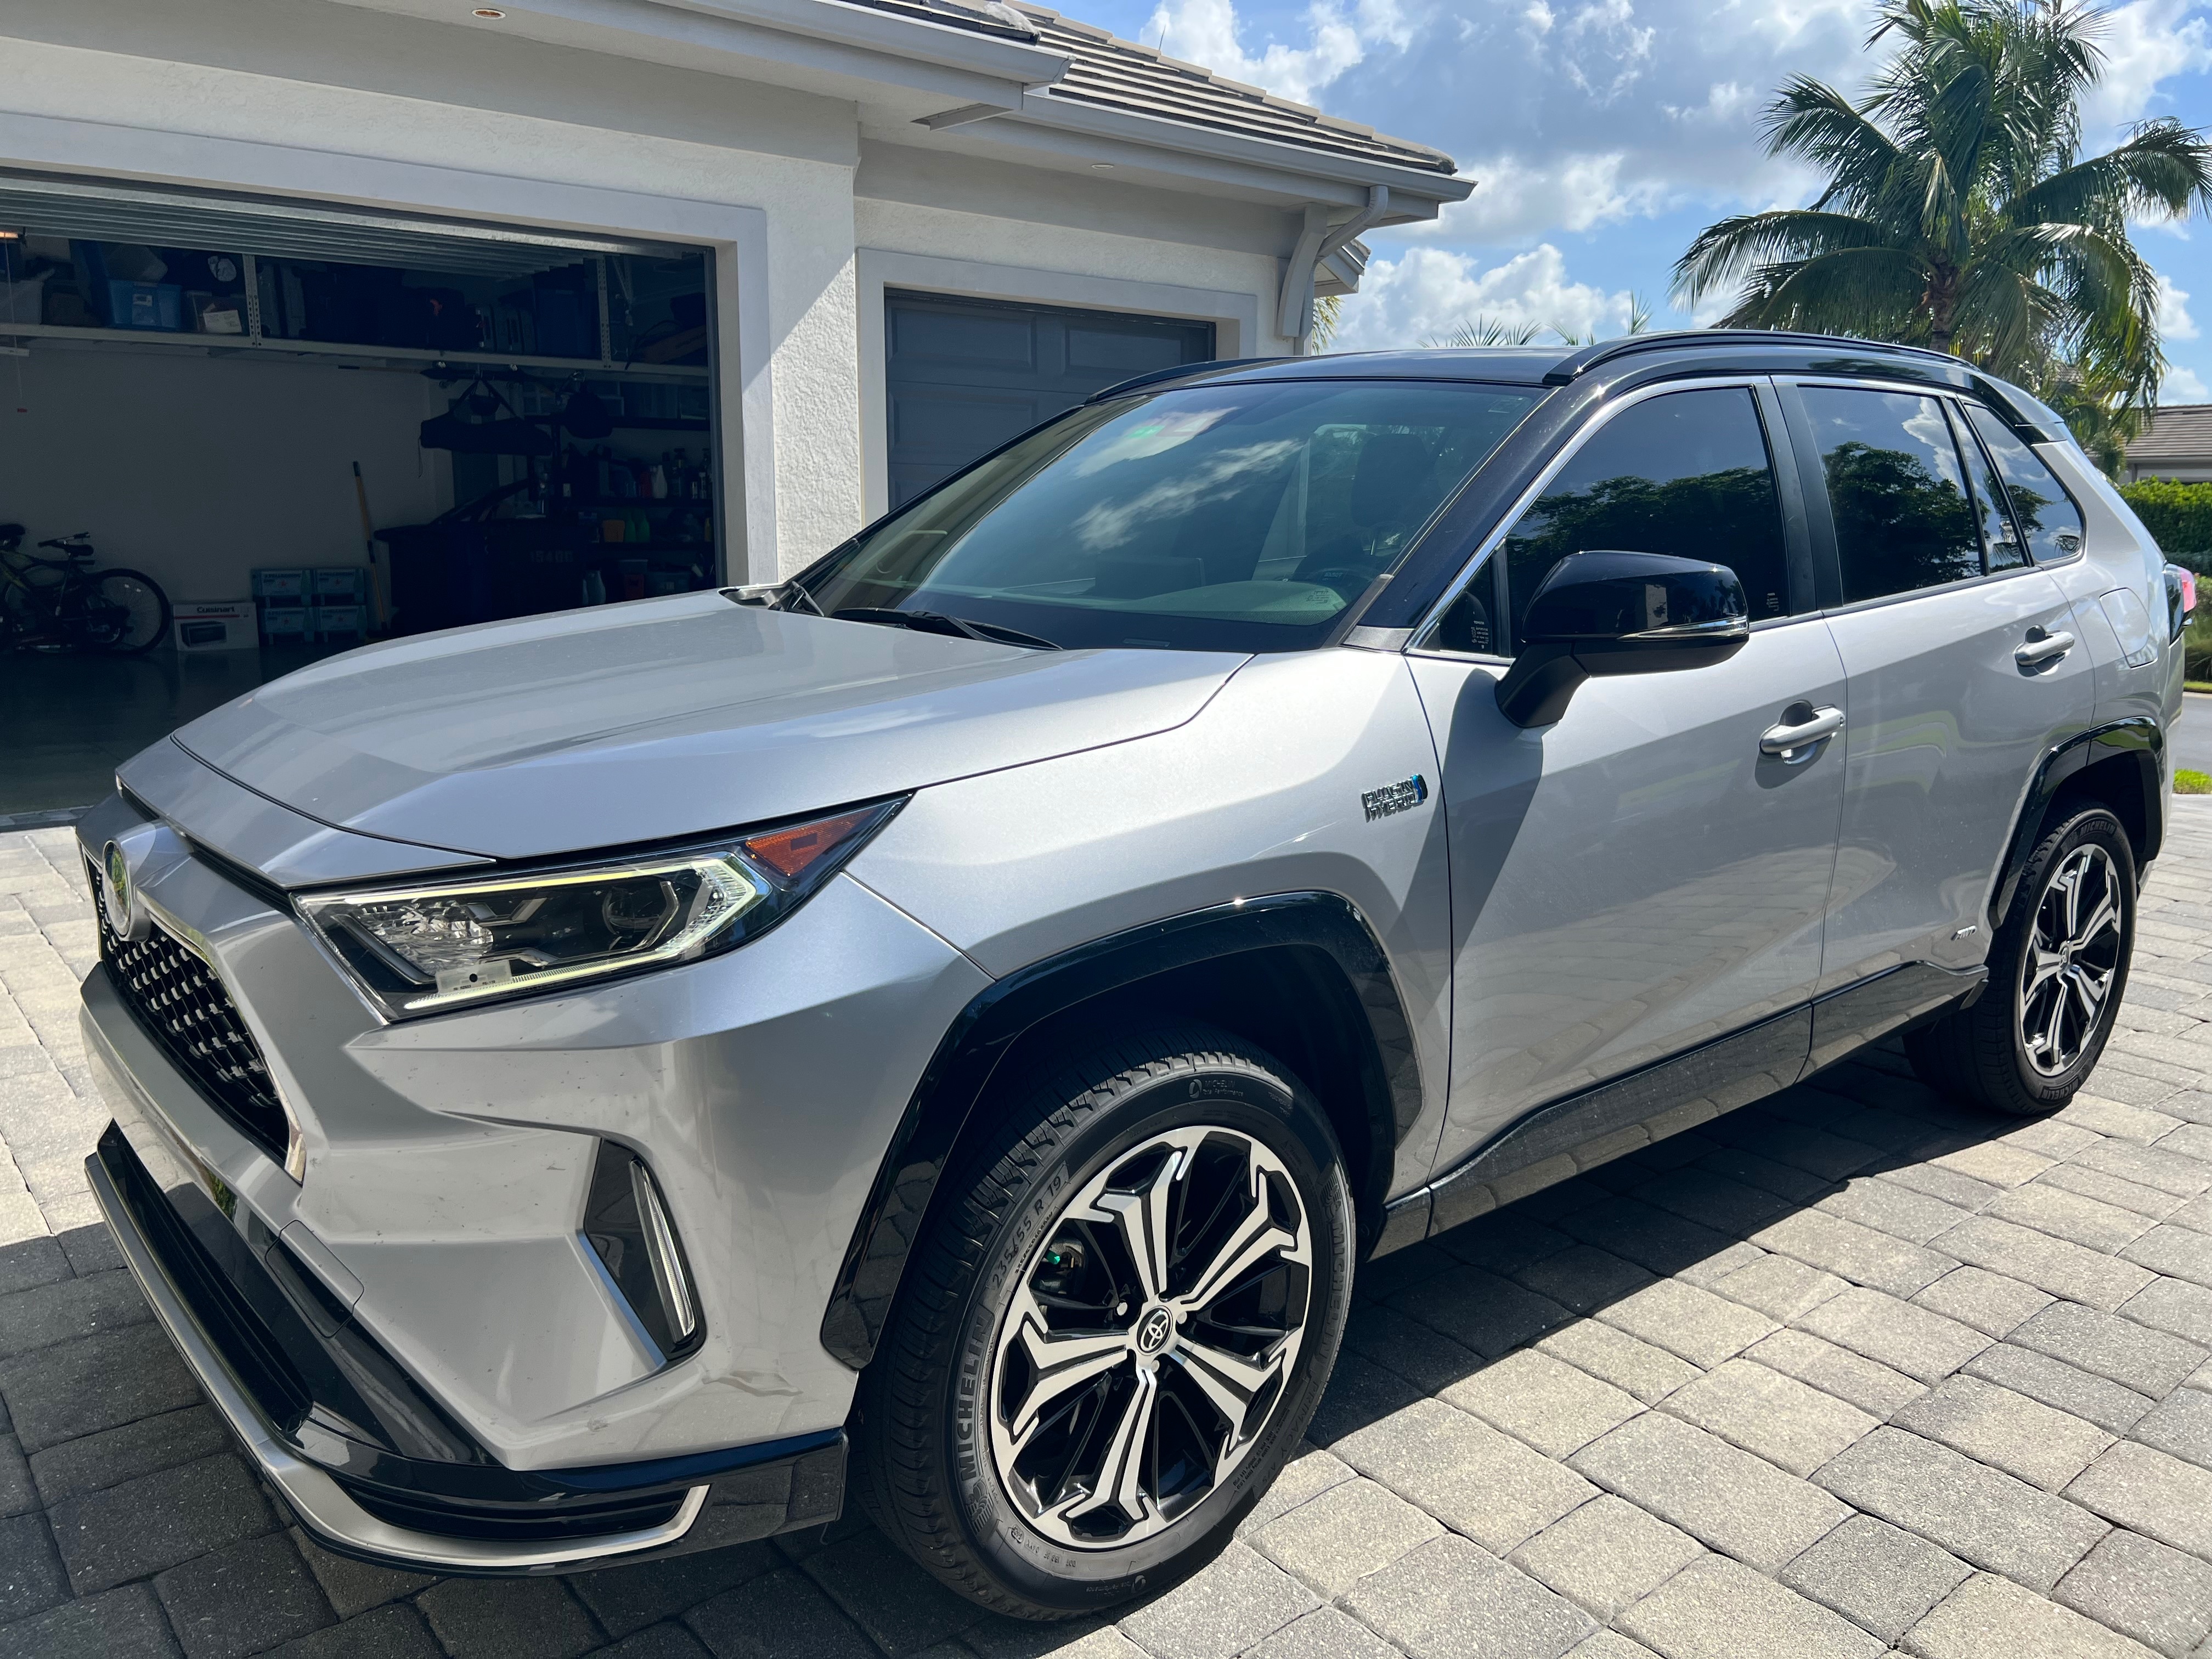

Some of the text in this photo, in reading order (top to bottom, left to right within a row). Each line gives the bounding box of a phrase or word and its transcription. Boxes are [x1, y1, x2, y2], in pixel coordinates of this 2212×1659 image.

[2080, 820, 2117, 837] MICHELIN
[1955, 925, 1977, 943] AWD
[2042, 1077, 2079, 1100] MICHELIN
[992, 1176, 1062, 1286] 235/55 R 19
[1319, 1222, 1345, 1359] MICHELIN
[957, 1317, 986, 1481] MICHELIN
[1280, 1380, 1319, 1459] PRIMACY
